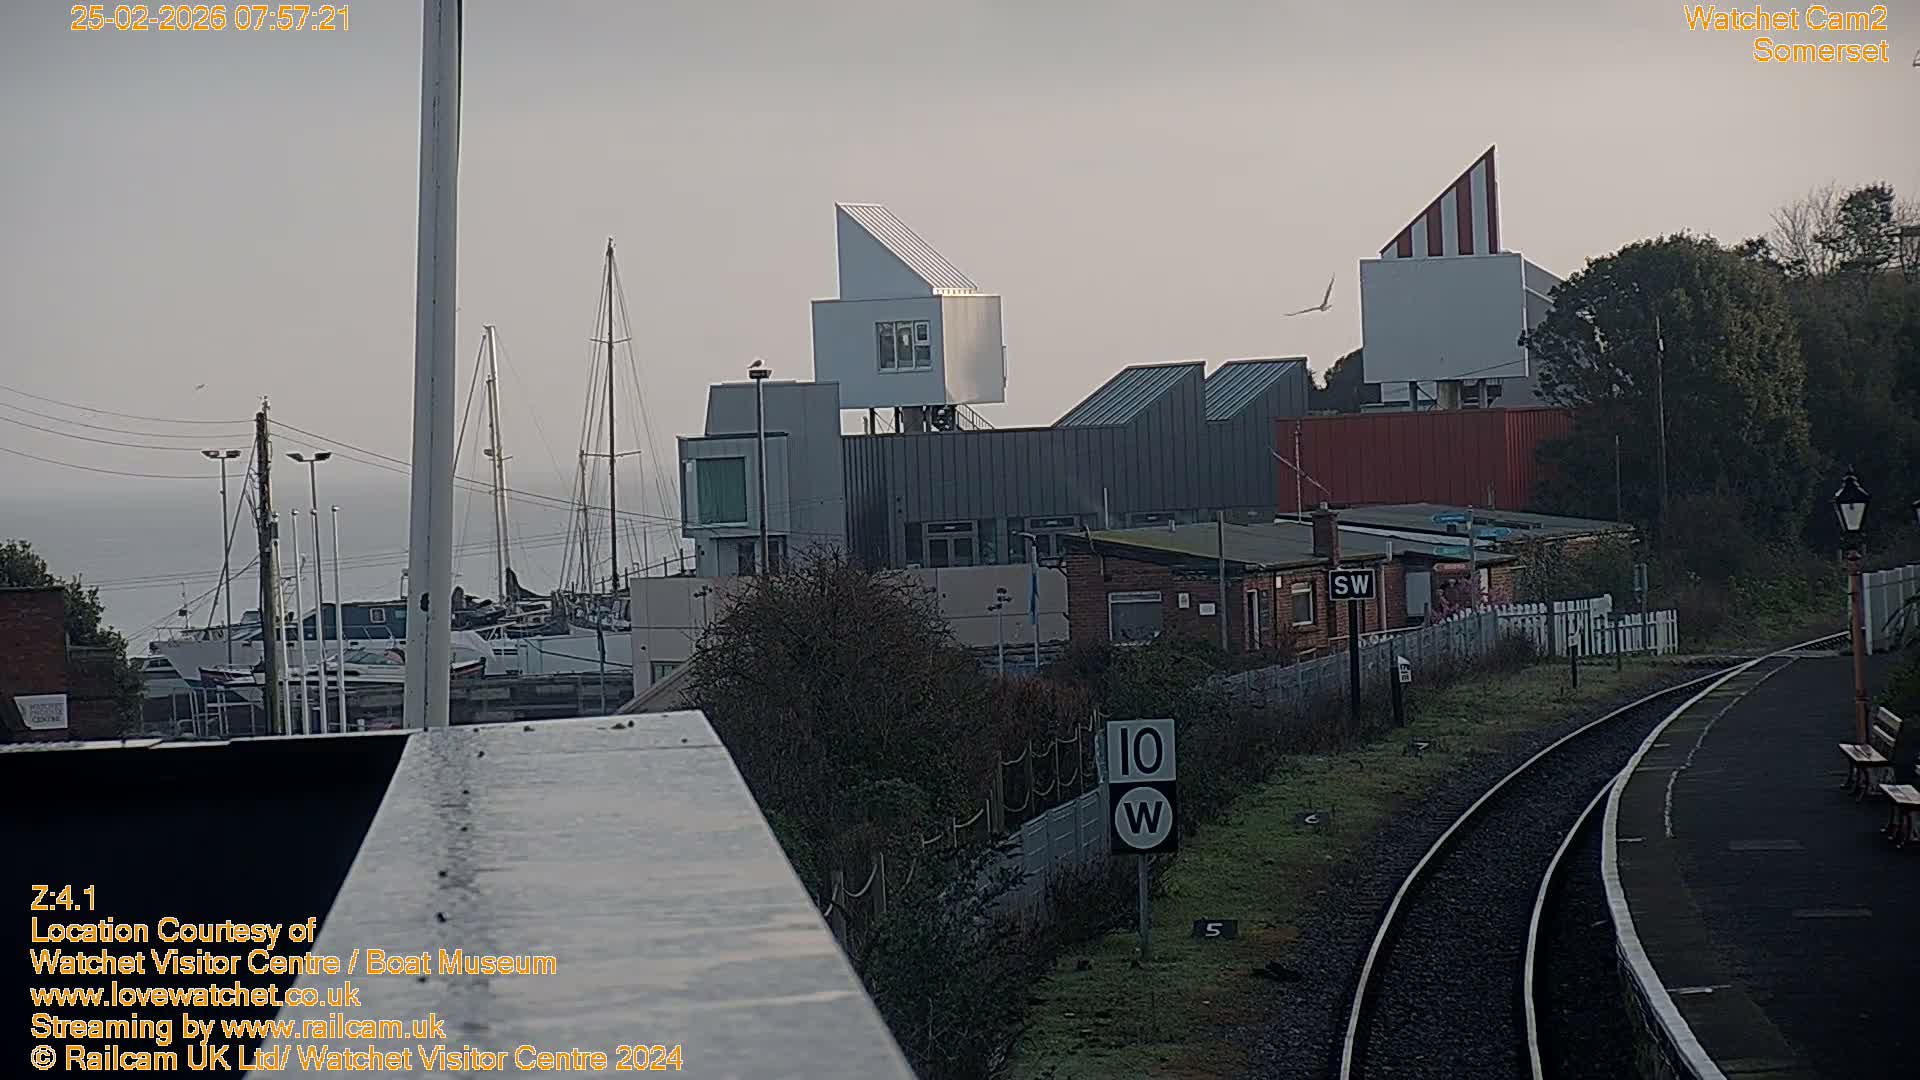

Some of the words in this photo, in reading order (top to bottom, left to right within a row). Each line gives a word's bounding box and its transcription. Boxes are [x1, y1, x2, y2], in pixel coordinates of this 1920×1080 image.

[1334, 574, 1369, 595] SW
[1120, 727, 1163, 776] 10
[1123, 800, 1163, 835] W
[1205, 922, 1223, 937] 5
